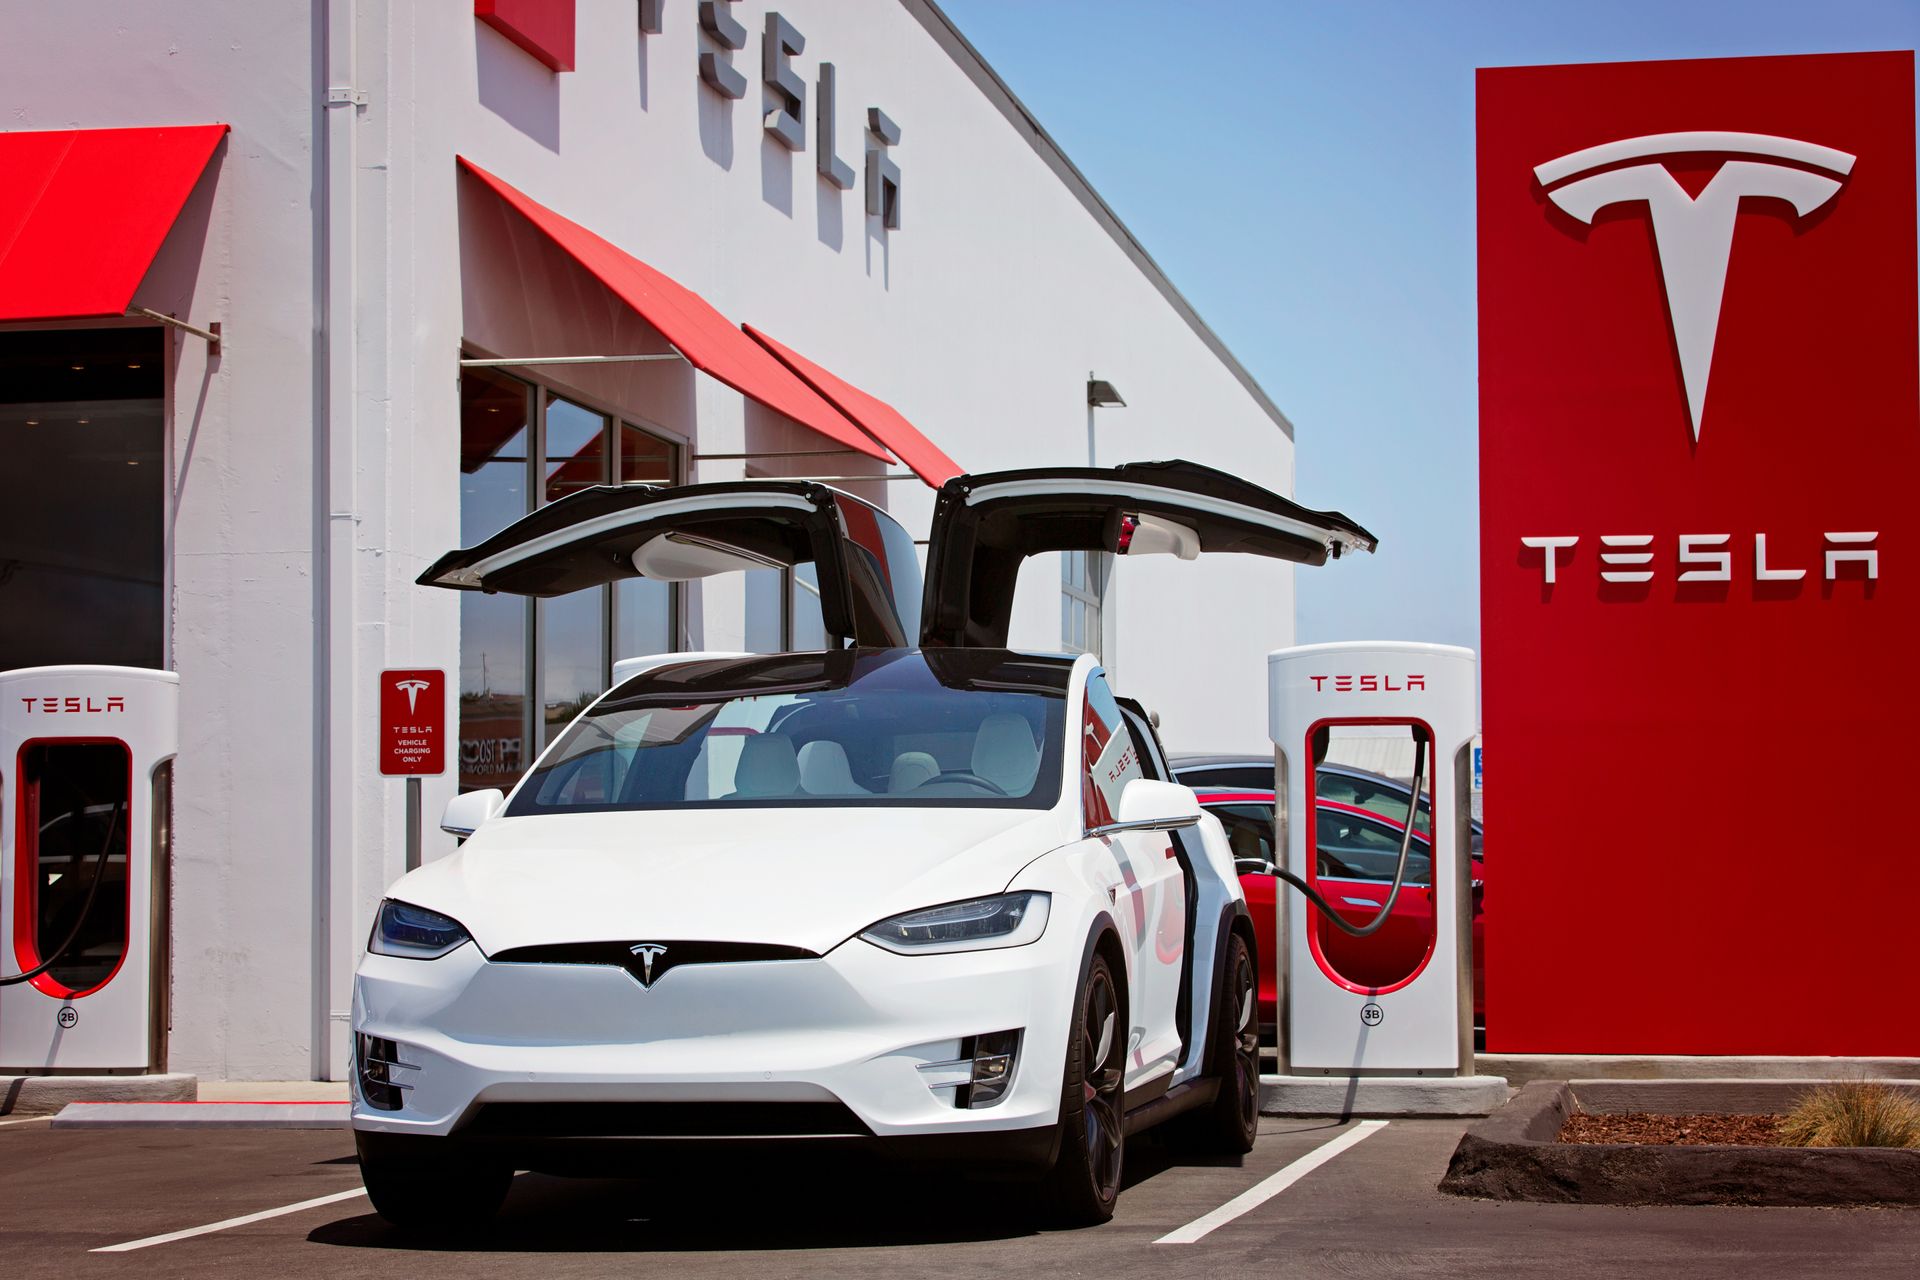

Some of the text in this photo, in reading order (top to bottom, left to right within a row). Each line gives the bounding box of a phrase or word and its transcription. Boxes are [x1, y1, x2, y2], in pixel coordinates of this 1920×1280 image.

[638, 0, 901, 230] ESLA
[1520, 531, 1879, 584] TESLA
[1309, 675, 1425, 692] TESLA
[21, 697, 125, 713] TESLA
[393, 726, 433, 734] TESLA
[60, 1012, 75, 1021] 2B
[1364, 1009, 1380, 1019] 3B
